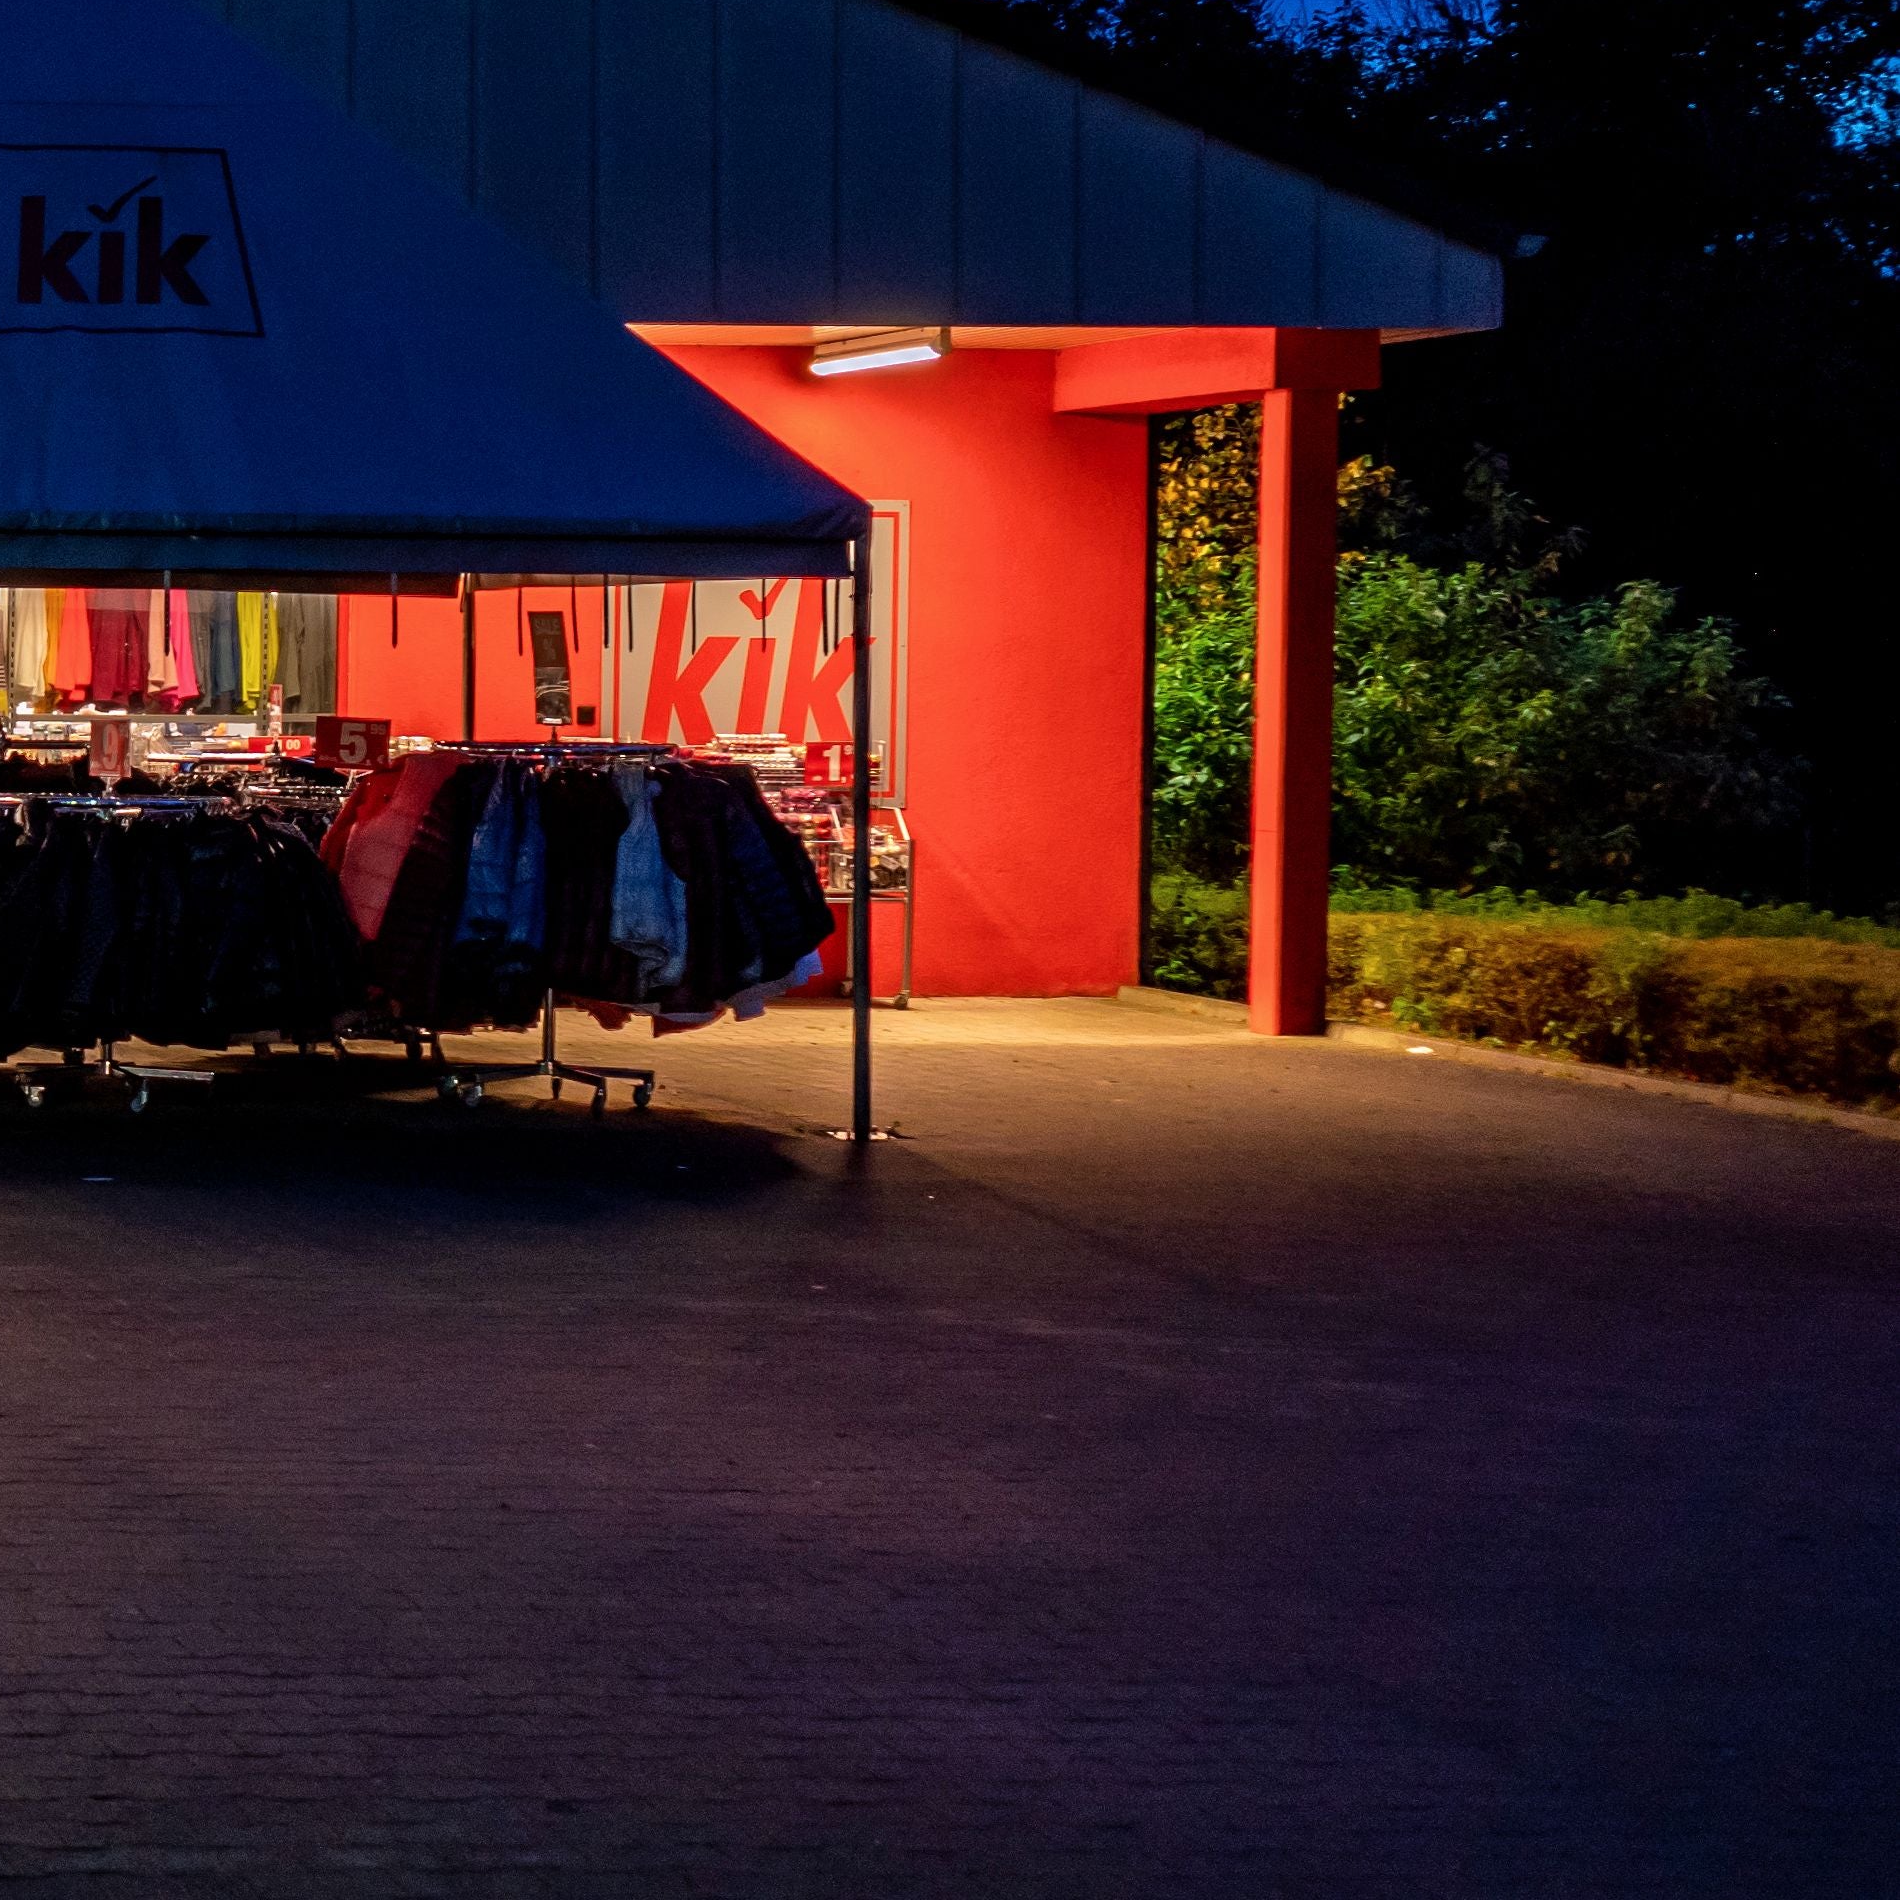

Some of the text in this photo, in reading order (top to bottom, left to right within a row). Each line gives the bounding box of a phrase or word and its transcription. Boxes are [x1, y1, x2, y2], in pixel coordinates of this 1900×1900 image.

[17, 175, 211, 306] kik
[641, 578, 877, 745] kik
[822, 744, 854, 783] 1,9
